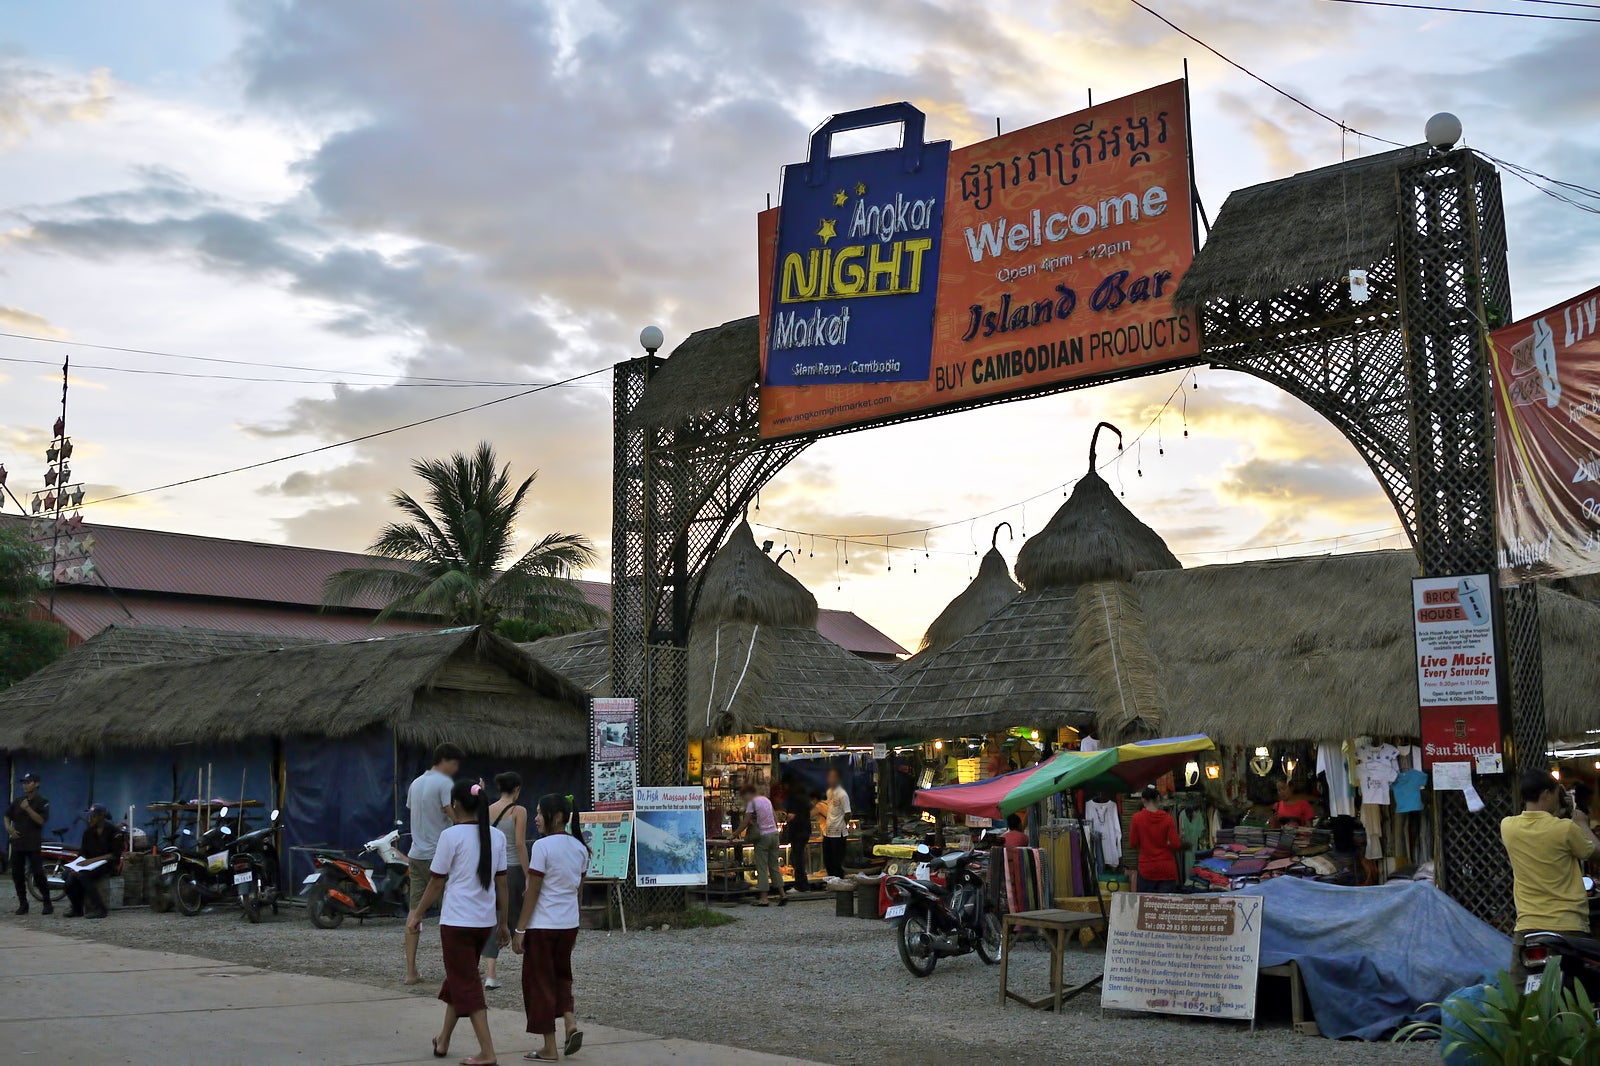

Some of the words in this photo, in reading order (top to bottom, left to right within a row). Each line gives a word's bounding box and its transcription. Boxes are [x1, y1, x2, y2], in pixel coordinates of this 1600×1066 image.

[848, 191, 936, 243] Angkor
[963, 186, 1168, 263] Welcome
[780, 238, 932, 303] NIGHT
[996, 263, 1036, 283] Open
[1040, 254, 1073, 272] 4pm
[961, 282, 1077, 342] Island
[1088, 269, 1172, 312] Bar
[935, 361, 967, 392] BUY
[971, 336, 1084, 385] CAMBODIAN
[1089, 314, 1191, 361] PRODUCTS
[848, 358, 900, 374] Cambodia
[1426, 591, 1456, 603] BRICK
[1420, 608, 1461, 620] HOUSE
[1420, 655, 1448, 668] Live
[1452, 652, 1492, 666] Music
[1424, 668, 1448, 679] Every
[1450, 666, 1490, 678] Saturday
[1425, 742, 1451, 756] San
[662, 792, 687, 802] Massage
[688, 792, 702, 801] Shop
